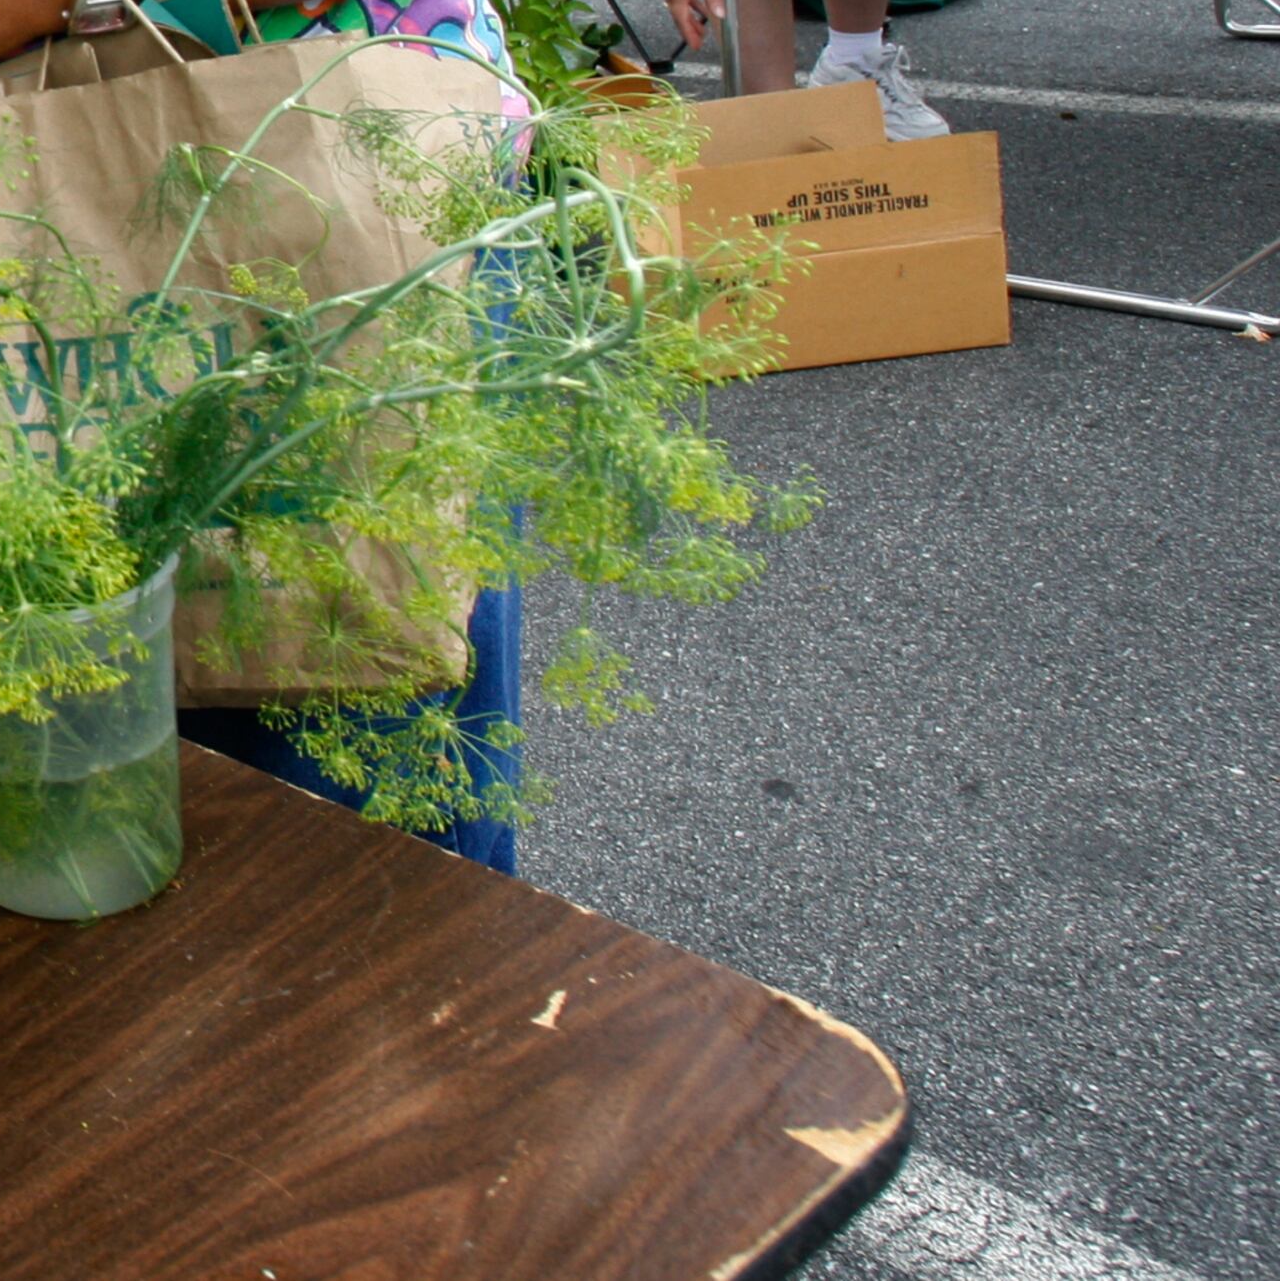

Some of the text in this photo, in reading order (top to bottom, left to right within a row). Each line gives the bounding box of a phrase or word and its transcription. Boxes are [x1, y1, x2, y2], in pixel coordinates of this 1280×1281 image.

[786, 192, 808, 208] UP
[813, 187, 849, 205] SIDE
[853, 182, 892, 200] THIS
